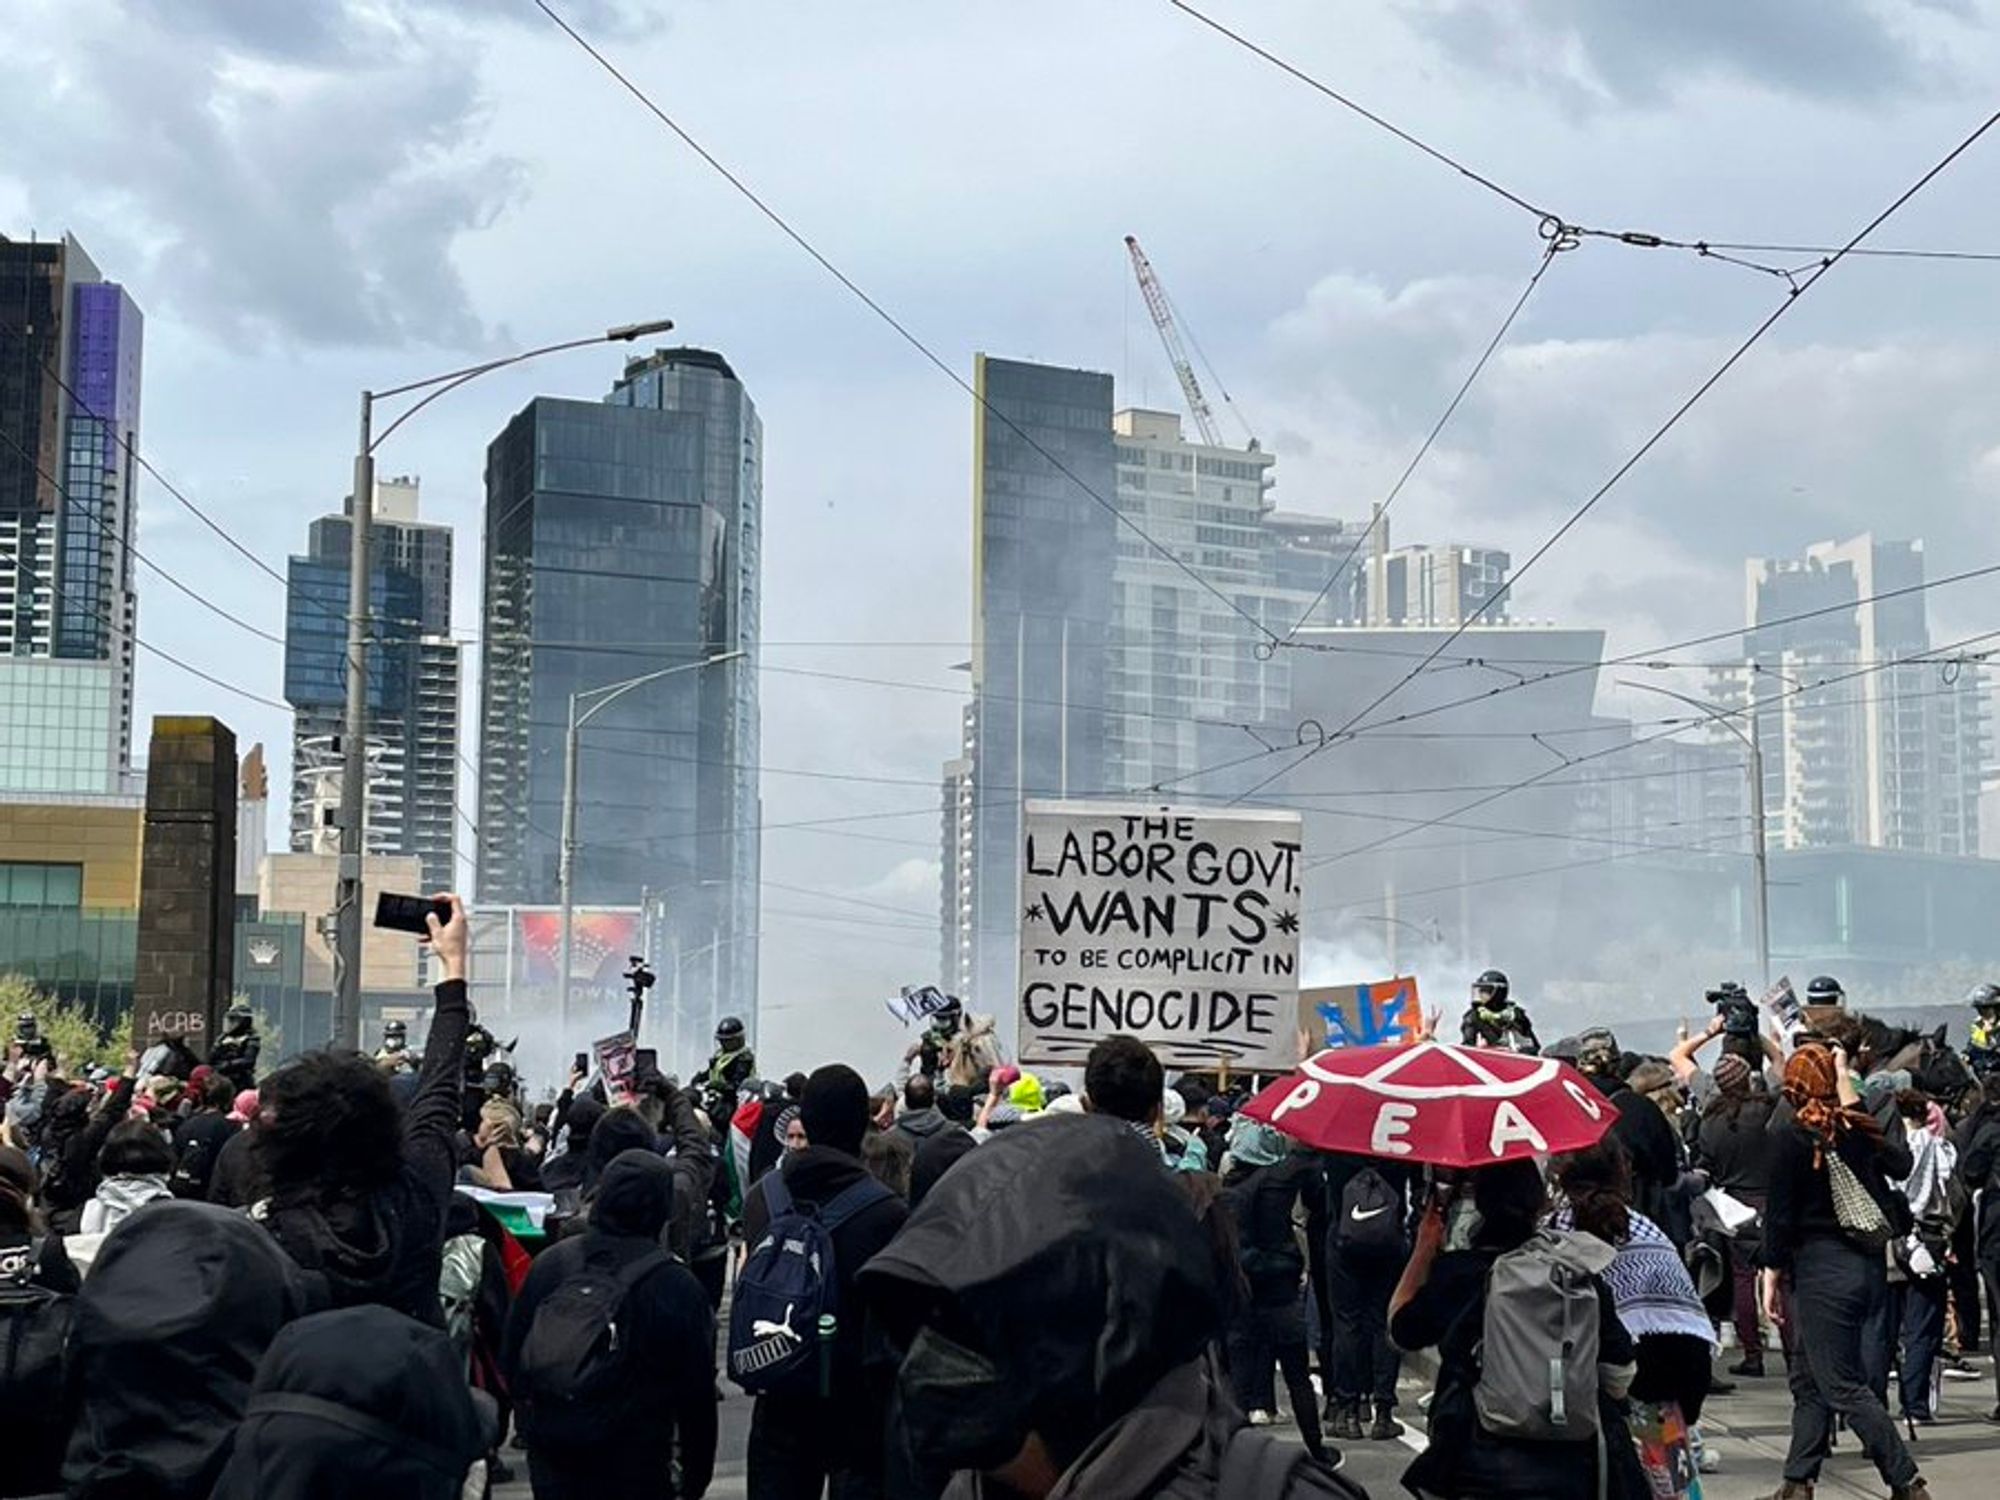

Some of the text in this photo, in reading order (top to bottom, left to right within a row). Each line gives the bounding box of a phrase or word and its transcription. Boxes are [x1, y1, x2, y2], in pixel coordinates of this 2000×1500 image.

[1121, 815, 1194, 841] THE
[1026, 830, 1301, 897] LABOR GOVT.
[1035, 947, 1293, 976] TO BE COMPLICIT IN
[148, 1010, 206, 1035] ACAB
[1024, 982, 1278, 1034] GENOCIDE
